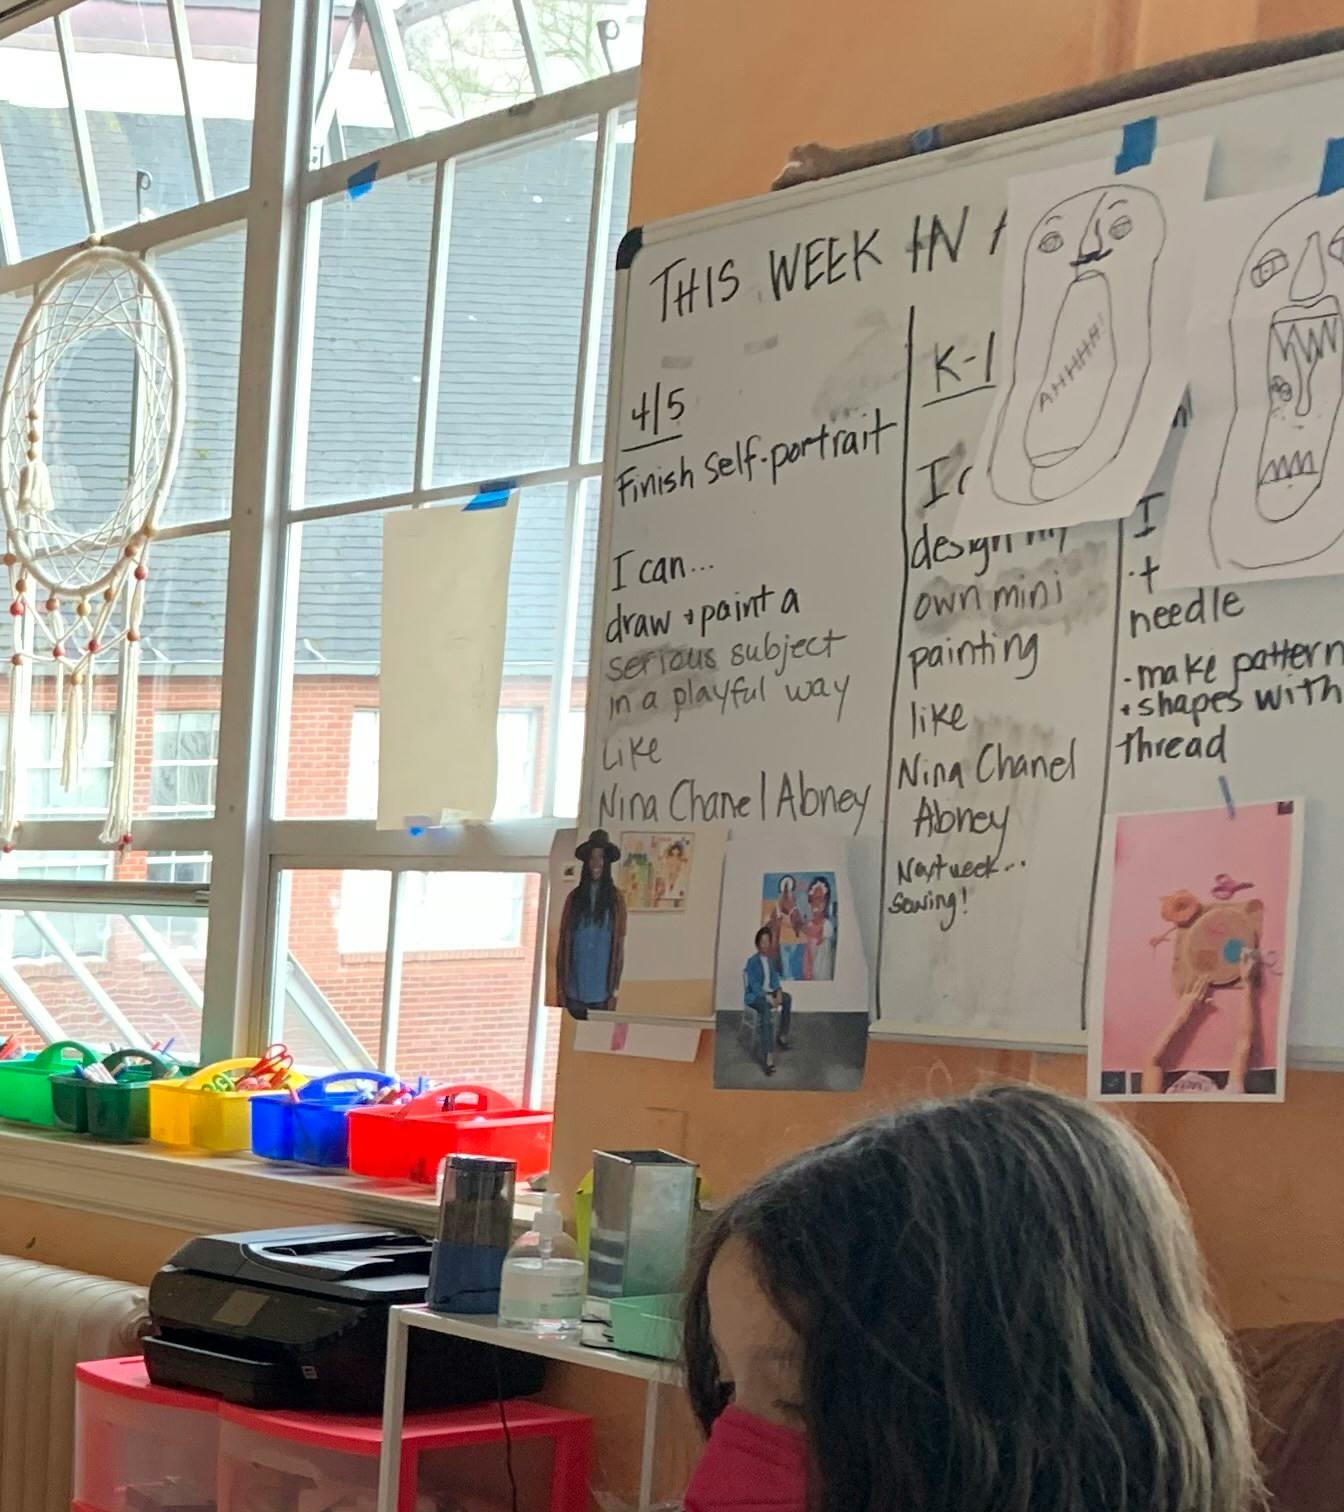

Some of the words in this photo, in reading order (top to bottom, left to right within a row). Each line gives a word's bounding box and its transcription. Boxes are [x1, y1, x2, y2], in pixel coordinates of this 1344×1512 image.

[650, 257, 740, 322] THIS
[770, 228, 883, 300] WEEK
[911, 205, 971, 273] IN
[934, 331, 995, 392] K-1
[632, 382, 685, 435] 4/5
[617, 456, 694, 507] Finish
[916, 455, 950, 509] I
[611, 550, 635, 592] I
[913, 584, 981, 621] own
[994, 570, 1063, 613] mini
[606, 603, 671, 643] draw
[701, 584, 775, 637] paint
[781, 588, 800, 615] a
[1129, 587, 1246, 638] needle
[606, 647, 717, 682] serious
[731, 629, 848, 677] subject
[907, 629, 1039, 690] painting
[642, 691, 658, 711] a
[673, 676, 766, 723] playful
[785, 675, 850, 723] way
[911, 700, 968, 740] like
[1137, 689, 1243, 728] shapes
[1255, 673, 1342, 711] with
[898, 752, 965, 789] Nina
[976, 737, 1076, 783] Chanel
[1115, 724, 1227, 765] thread
[599, 782, 658, 827] Nina
[669, 770, 766, 822] Chanel
[776, 769, 872, 836] Abney
[913, 795, 1010, 860] Abney
